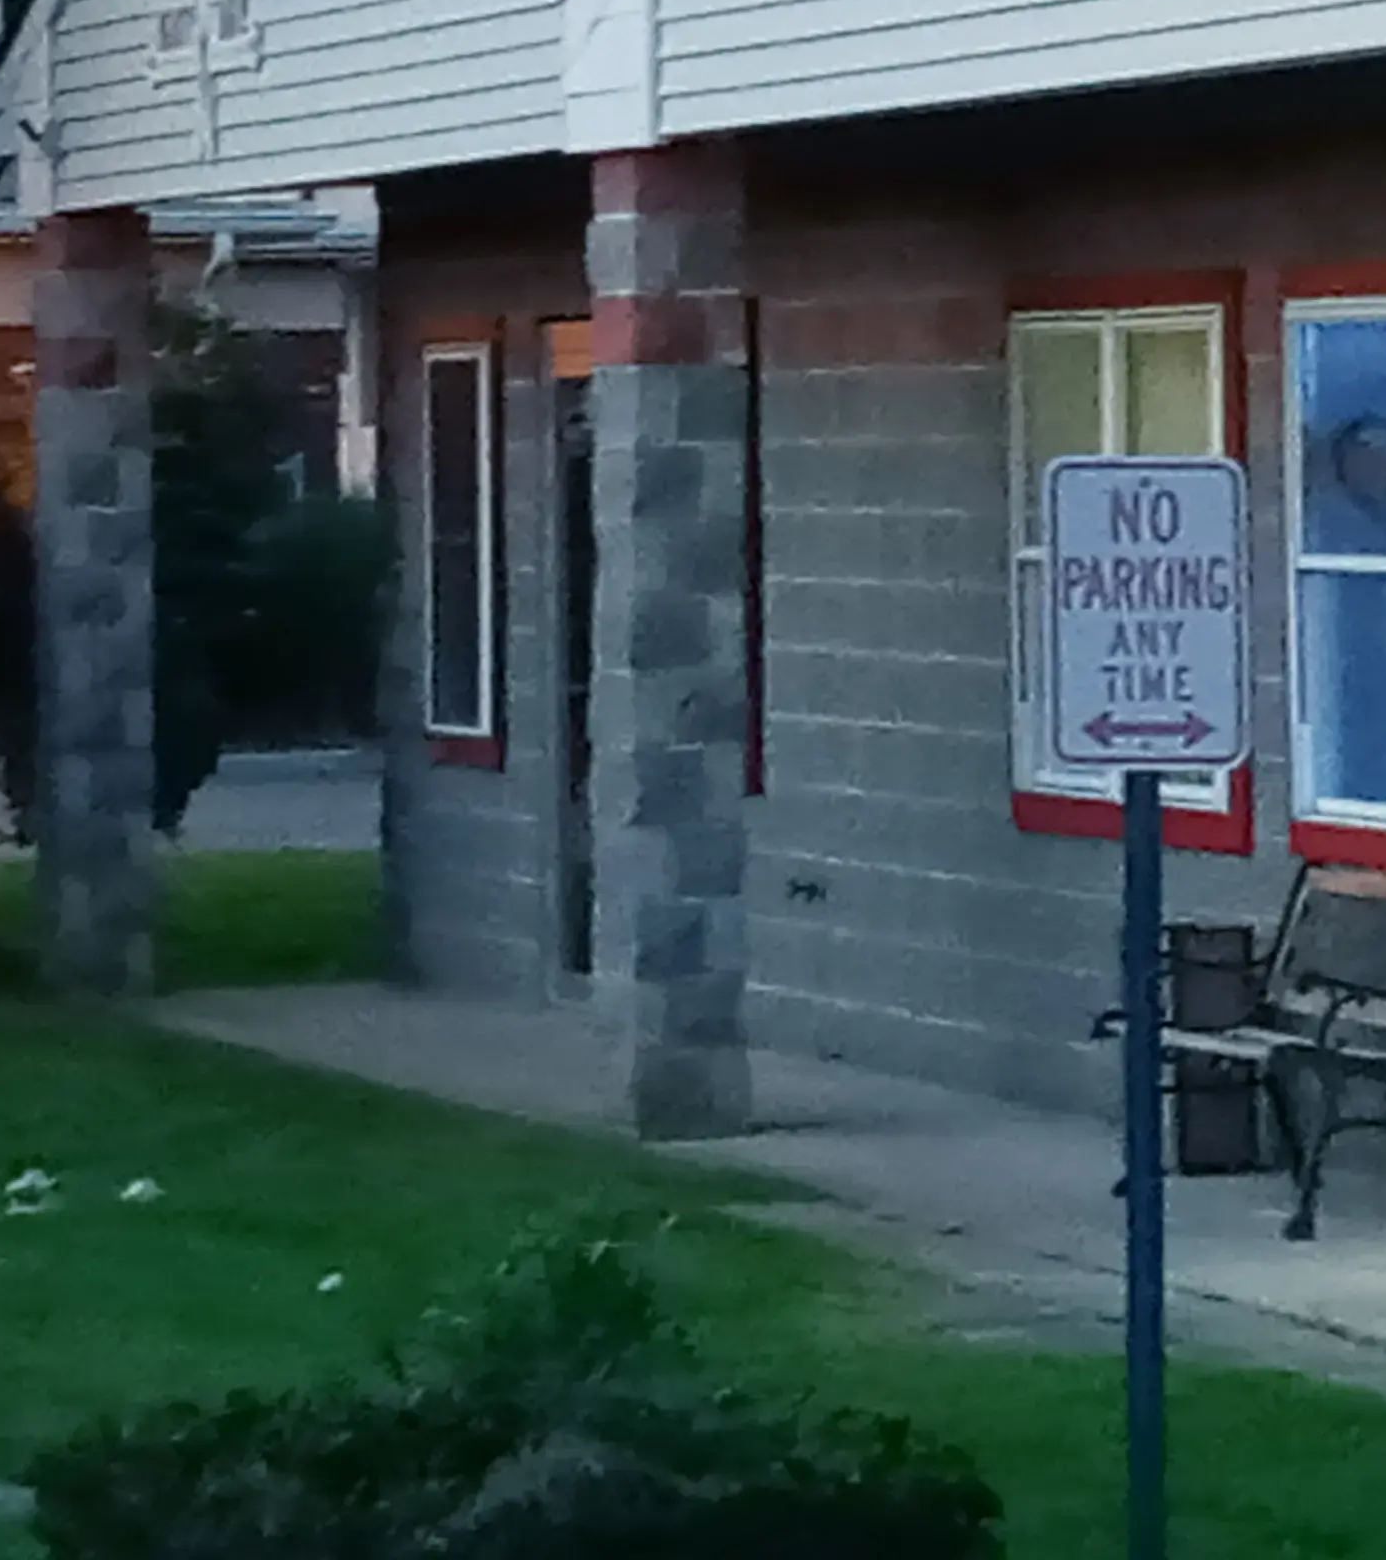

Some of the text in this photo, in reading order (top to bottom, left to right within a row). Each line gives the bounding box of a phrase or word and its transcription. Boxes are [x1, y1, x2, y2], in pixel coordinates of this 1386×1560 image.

[1107, 490, 1182, 544] NO
[1062, 556, 1230, 611] PARKING
[1109, 620, 1184, 657] ANY
[1100, 664, 1194, 703] TIME
